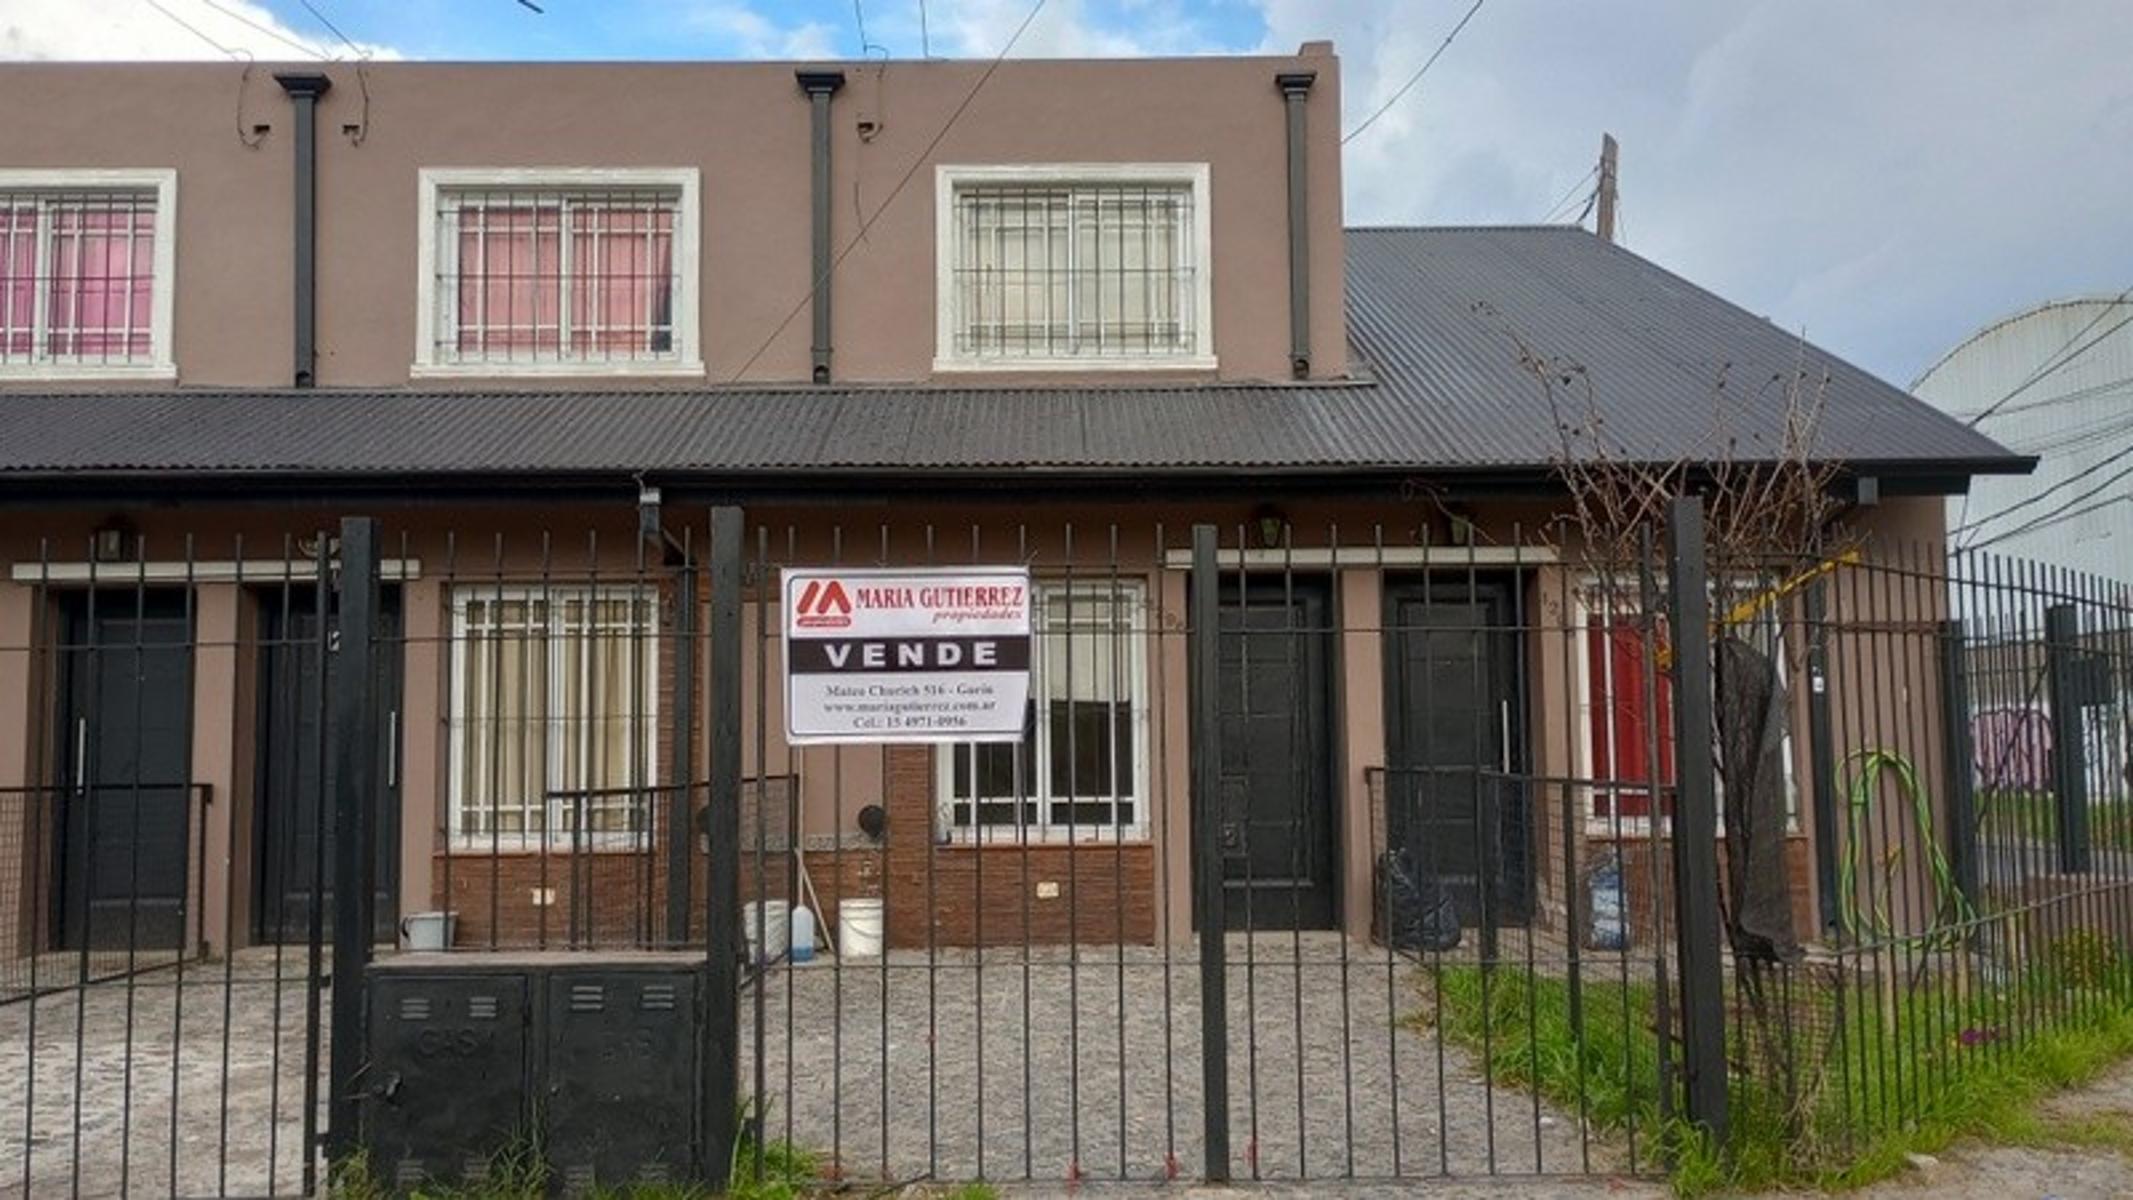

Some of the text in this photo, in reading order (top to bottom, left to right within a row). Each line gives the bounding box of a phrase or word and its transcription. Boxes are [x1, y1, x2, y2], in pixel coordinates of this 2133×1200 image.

[856, 585, 1023, 609] MARIA GUTIERREZ
[933, 608, 1022, 624] propiedades
[823, 641, 998, 668] VENDE
[826, 684, 865, 697] Mateo
[923, 684, 945, 696] 516
[823, 700, 996, 716] www.mariagutierrez.com.ar
[886, 715, 901, 728] 15
